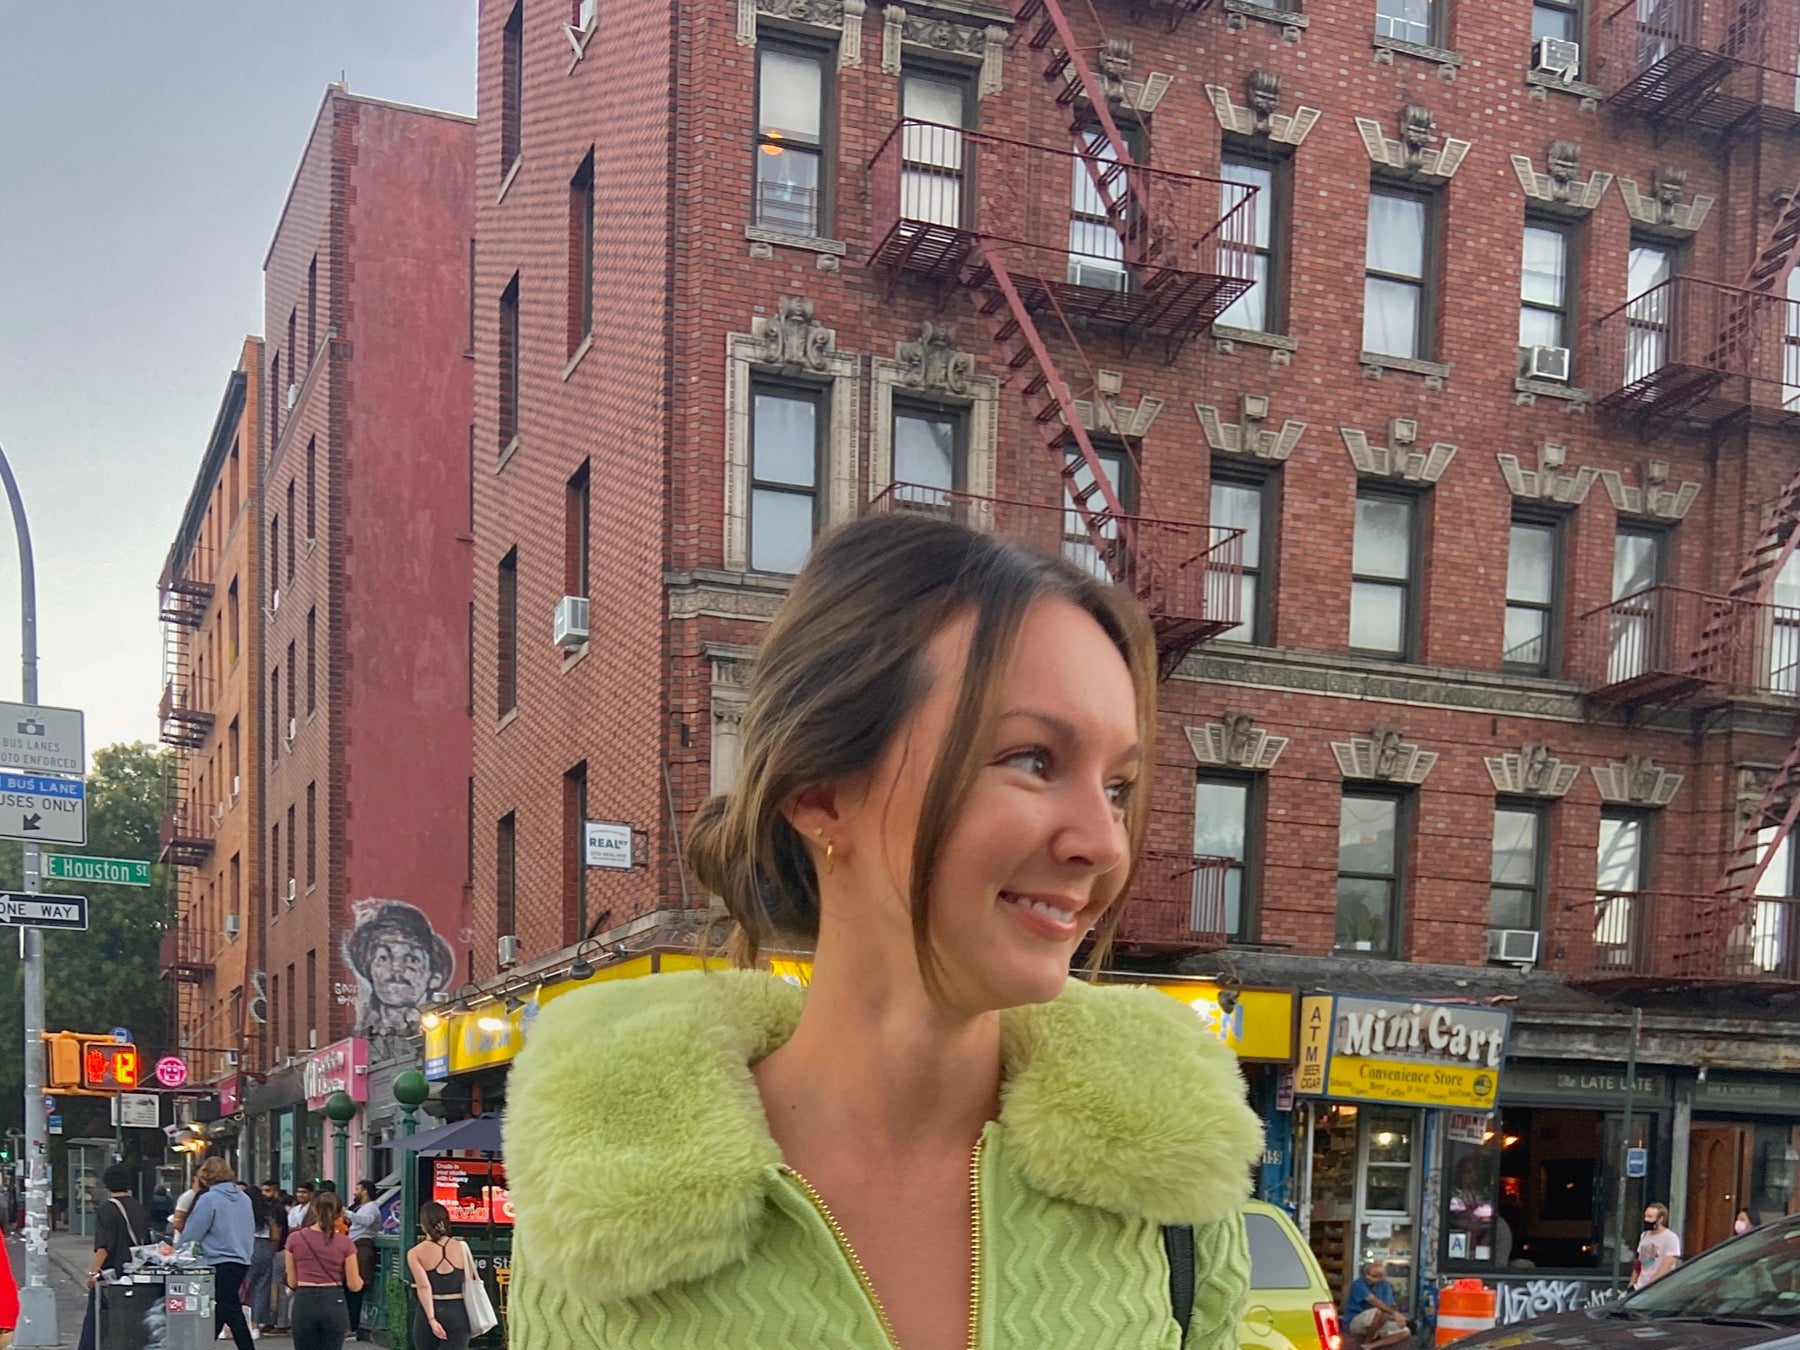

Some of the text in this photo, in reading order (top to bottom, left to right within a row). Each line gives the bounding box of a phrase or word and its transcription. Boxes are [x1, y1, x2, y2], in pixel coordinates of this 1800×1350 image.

[3, 738, 60, 753] BUS LANES
[0, 753, 77, 769] OTO ENFORCED
[7, 778, 78, 795] BUS LANE
[0, 794, 79, 813] USES ONLY
[589, 837, 621, 850] REAL
[49, 857, 147, 881] E Houston St
[0, 902, 73, 919] ONE WAY
[1305, 1006, 1322, 1062] ATM
[1344, 1003, 1504, 1068] Mini Cart
[1303, 1064, 1320, 1076] BEER
[1359, 1063, 1464, 1087] Convenience Store
[1300, 1077, 1321, 1089] CIGAR
[1580, 1075, 1614, 1090] LATE
[1451, 1237, 1463, 1251] A
